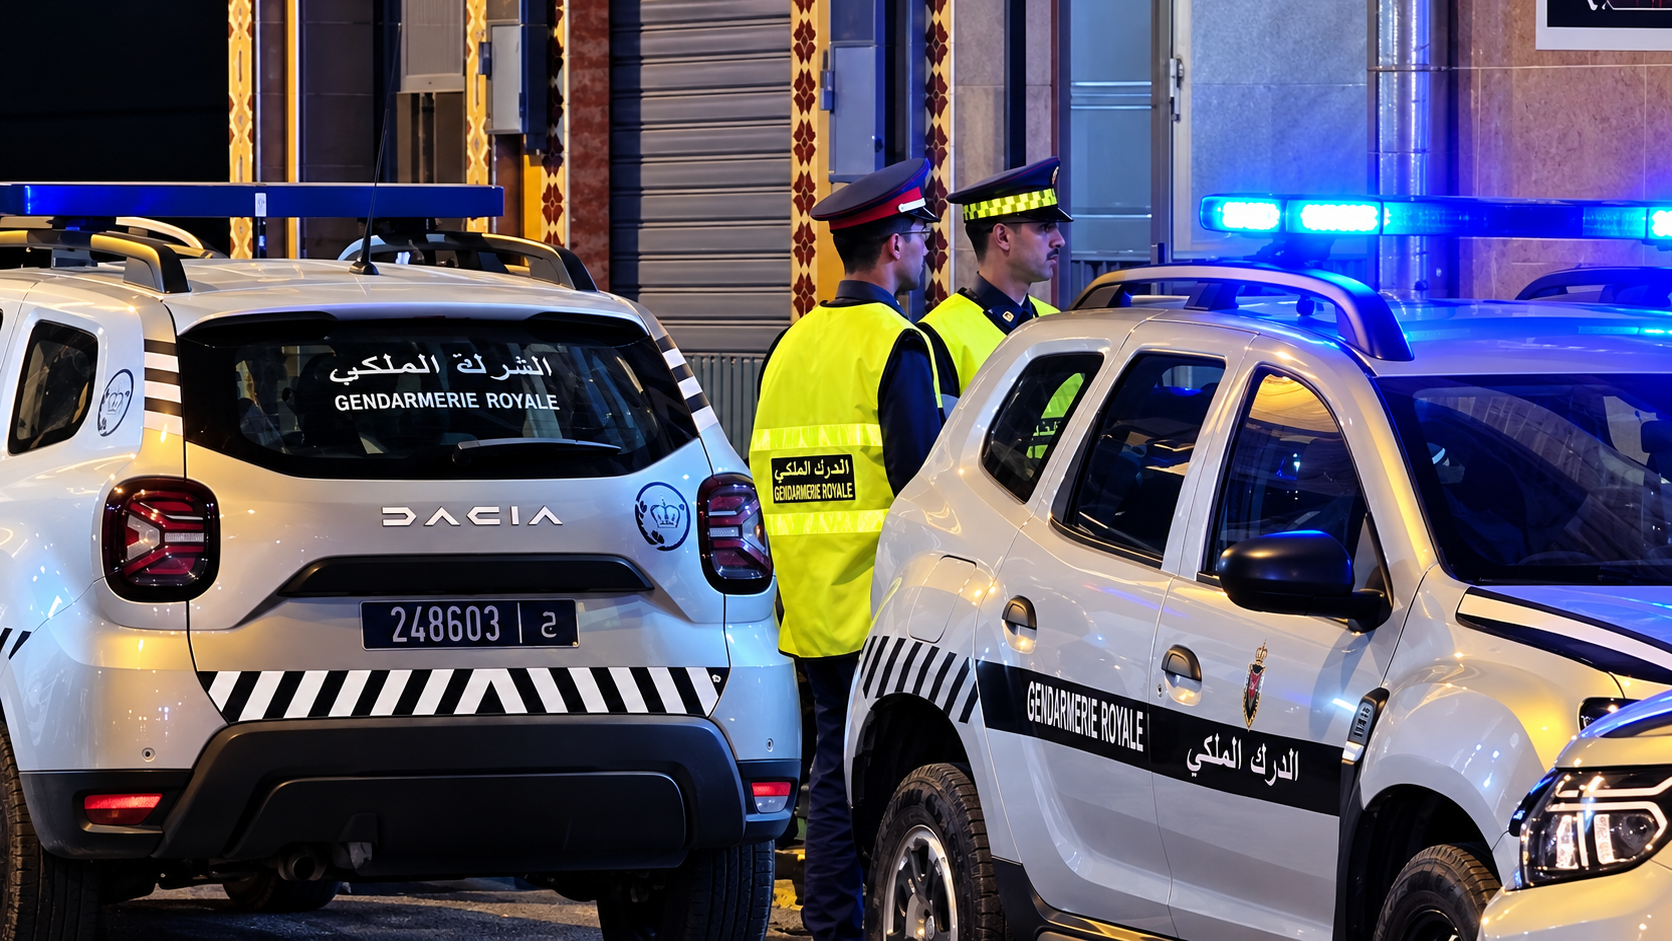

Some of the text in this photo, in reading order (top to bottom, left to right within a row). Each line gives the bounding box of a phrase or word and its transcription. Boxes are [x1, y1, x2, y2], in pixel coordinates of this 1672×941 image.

[329, 353, 440, 386] الملكي
[334, 392, 561, 412] GENDARMERIE ROYALE
[774, 458, 850, 484] الدرك الملكي
[822, 482, 854, 499] ROYALE
[381, 505, 563, 526] DACIA
[390, 605, 500, 642] 248603
[1027, 680, 1144, 752] GENDARMERIE ROYALE
[1186, 732, 1299, 787] الدرك الملكي
